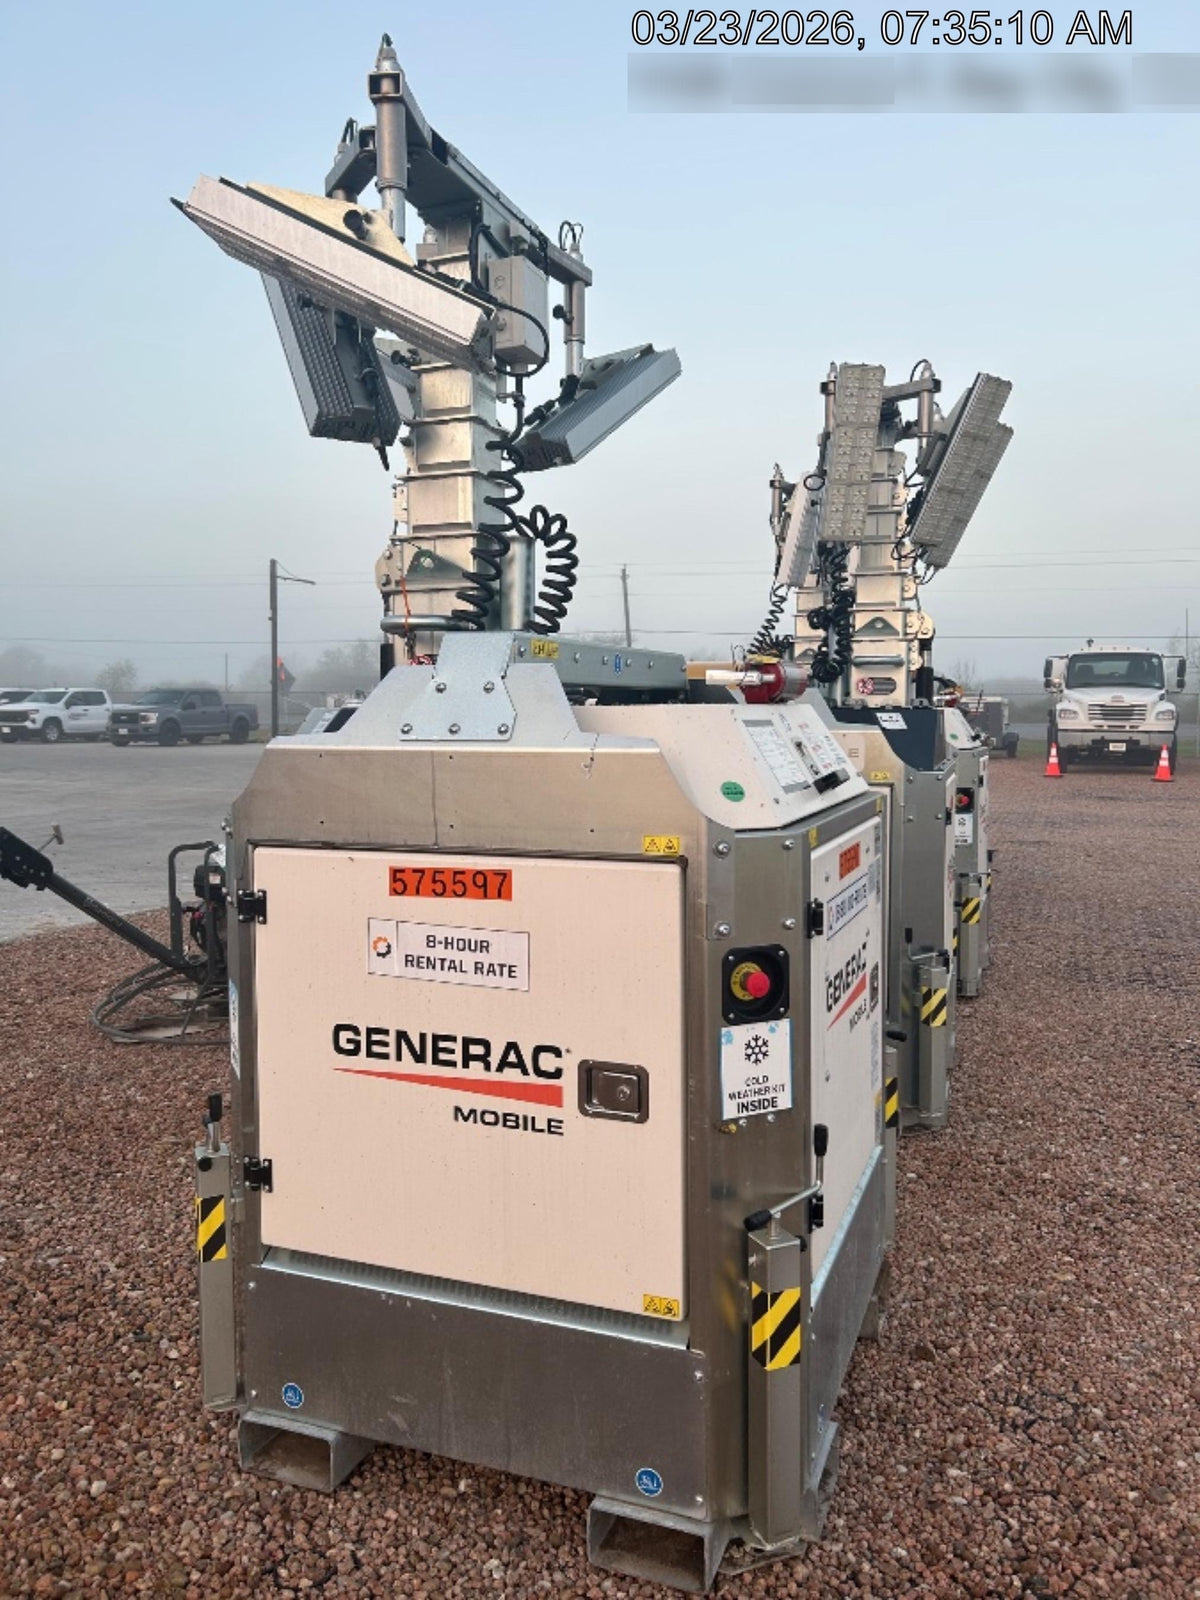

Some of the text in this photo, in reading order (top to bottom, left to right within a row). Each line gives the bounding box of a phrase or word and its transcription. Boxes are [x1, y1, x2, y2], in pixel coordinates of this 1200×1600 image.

[391, 868, 508, 898] 575597
[425, 934, 491, 954] 8-HOUR
[404, 954, 518, 979] RENTAL RATE
[332, 1023, 564, 1080] GENERAC
[744, 1075, 769, 1087] COLD
[728, 1084, 786, 1102] WEATHER KIT
[736, 1096, 779, 1115] INSIDE
[453, 1105, 565, 1137] MOBILE
